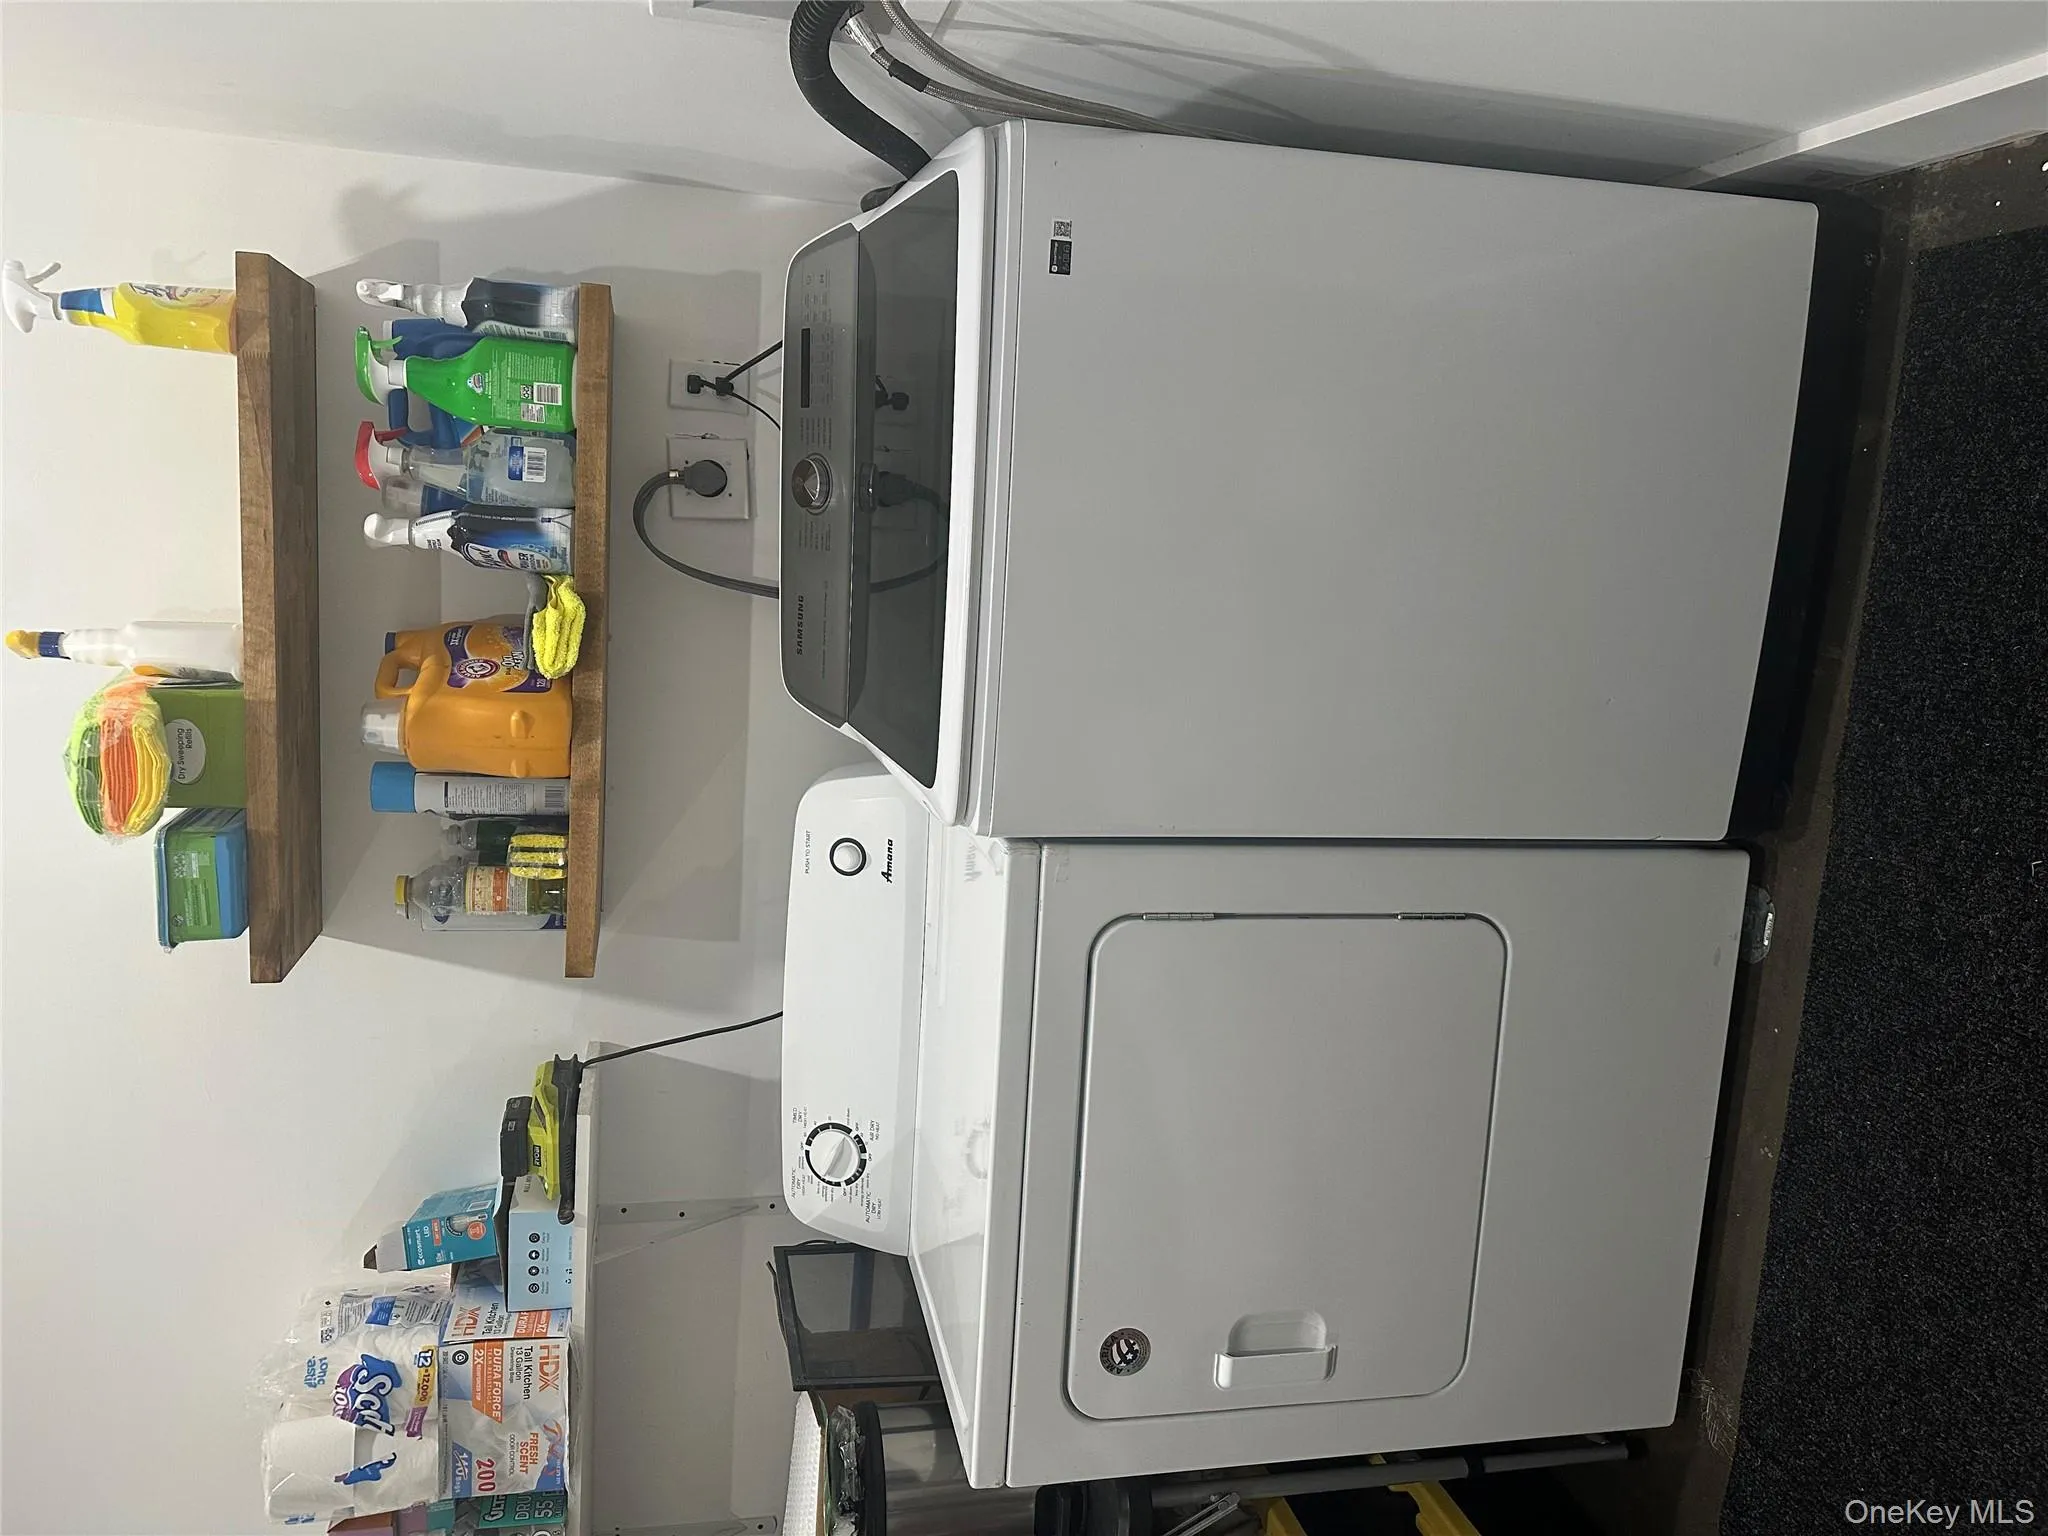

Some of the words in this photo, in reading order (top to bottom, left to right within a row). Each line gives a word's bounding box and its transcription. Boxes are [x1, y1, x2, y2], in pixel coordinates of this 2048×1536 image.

[176, 728, 185, 765] Sweeping
[178, 767, 186, 780] Dry
[881, 839, 893, 883] Amana
[414, 1228, 424, 1258] ecosmart
[452, 1306, 481, 1336] HDX
[485, 1302, 499, 1324] Kitchen
[517, 1316, 528, 1334] DURA
[536, 1324, 547, 1332] 2X
[482, 1326, 492, 1335] Tall
[417, 1349, 433, 1368] 12
[474, 1349, 484, 1364] 2X
[493, 1348, 502, 1379] DURA
[516, 1346, 523, 1355] 13
[524, 1346, 533, 1362] Tall
[1102, 1335, 1123, 1374] AMERICA
[523, 1364, 532, 1400] Kitchen
[539, 1344, 559, 1392] HDX
[492, 1382, 501, 1417] FORCE
[520, 1442, 528, 1474] SCENT
[530, 1432, 538, 1464] FRESH
[476, 1458, 495, 1492] 200
[514, 1494, 532, 1520] DRU
[534, 1500, 553, 1518] 55
